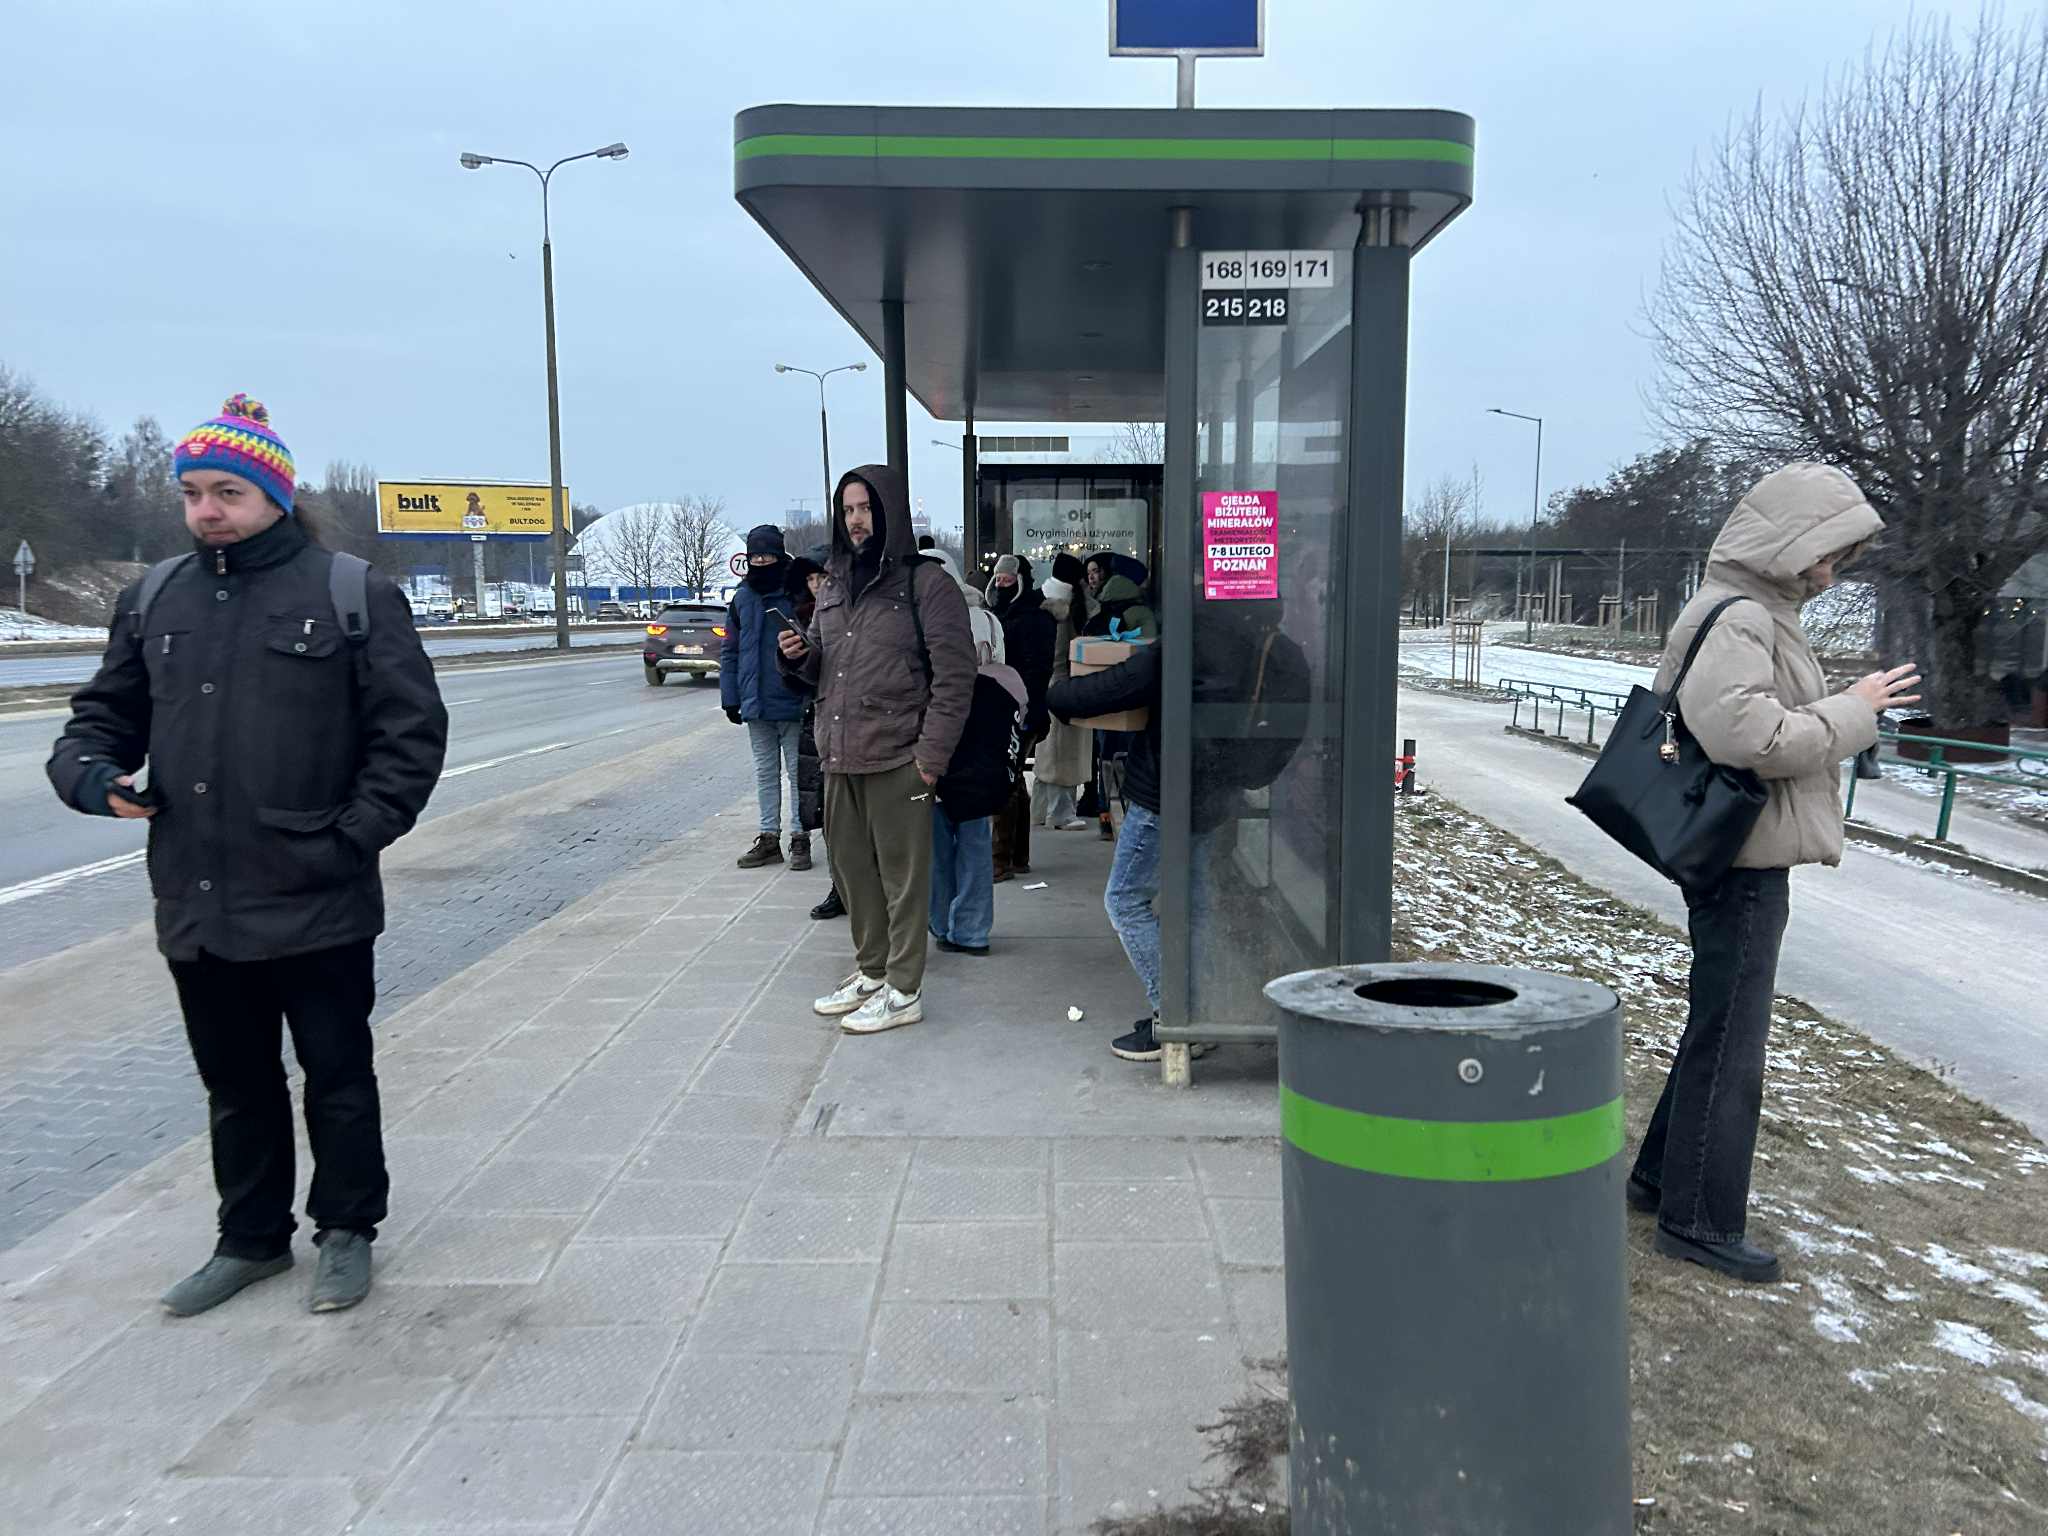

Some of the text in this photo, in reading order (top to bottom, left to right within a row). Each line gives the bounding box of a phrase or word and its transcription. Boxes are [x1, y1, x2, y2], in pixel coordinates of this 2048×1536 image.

[1206, 260, 1328, 279] 168 169 171
[1206, 298, 1286, 317] 215 218
[398, 494, 440, 511] bult
[1215, 506, 1266, 517] BIŻUTERII
[1207, 517, 1274, 528] MINERAŁÓW
[1211, 546, 1271, 556] 7-8 LUTEGO
[1213, 557, 1267, 571] POZNAŃ
